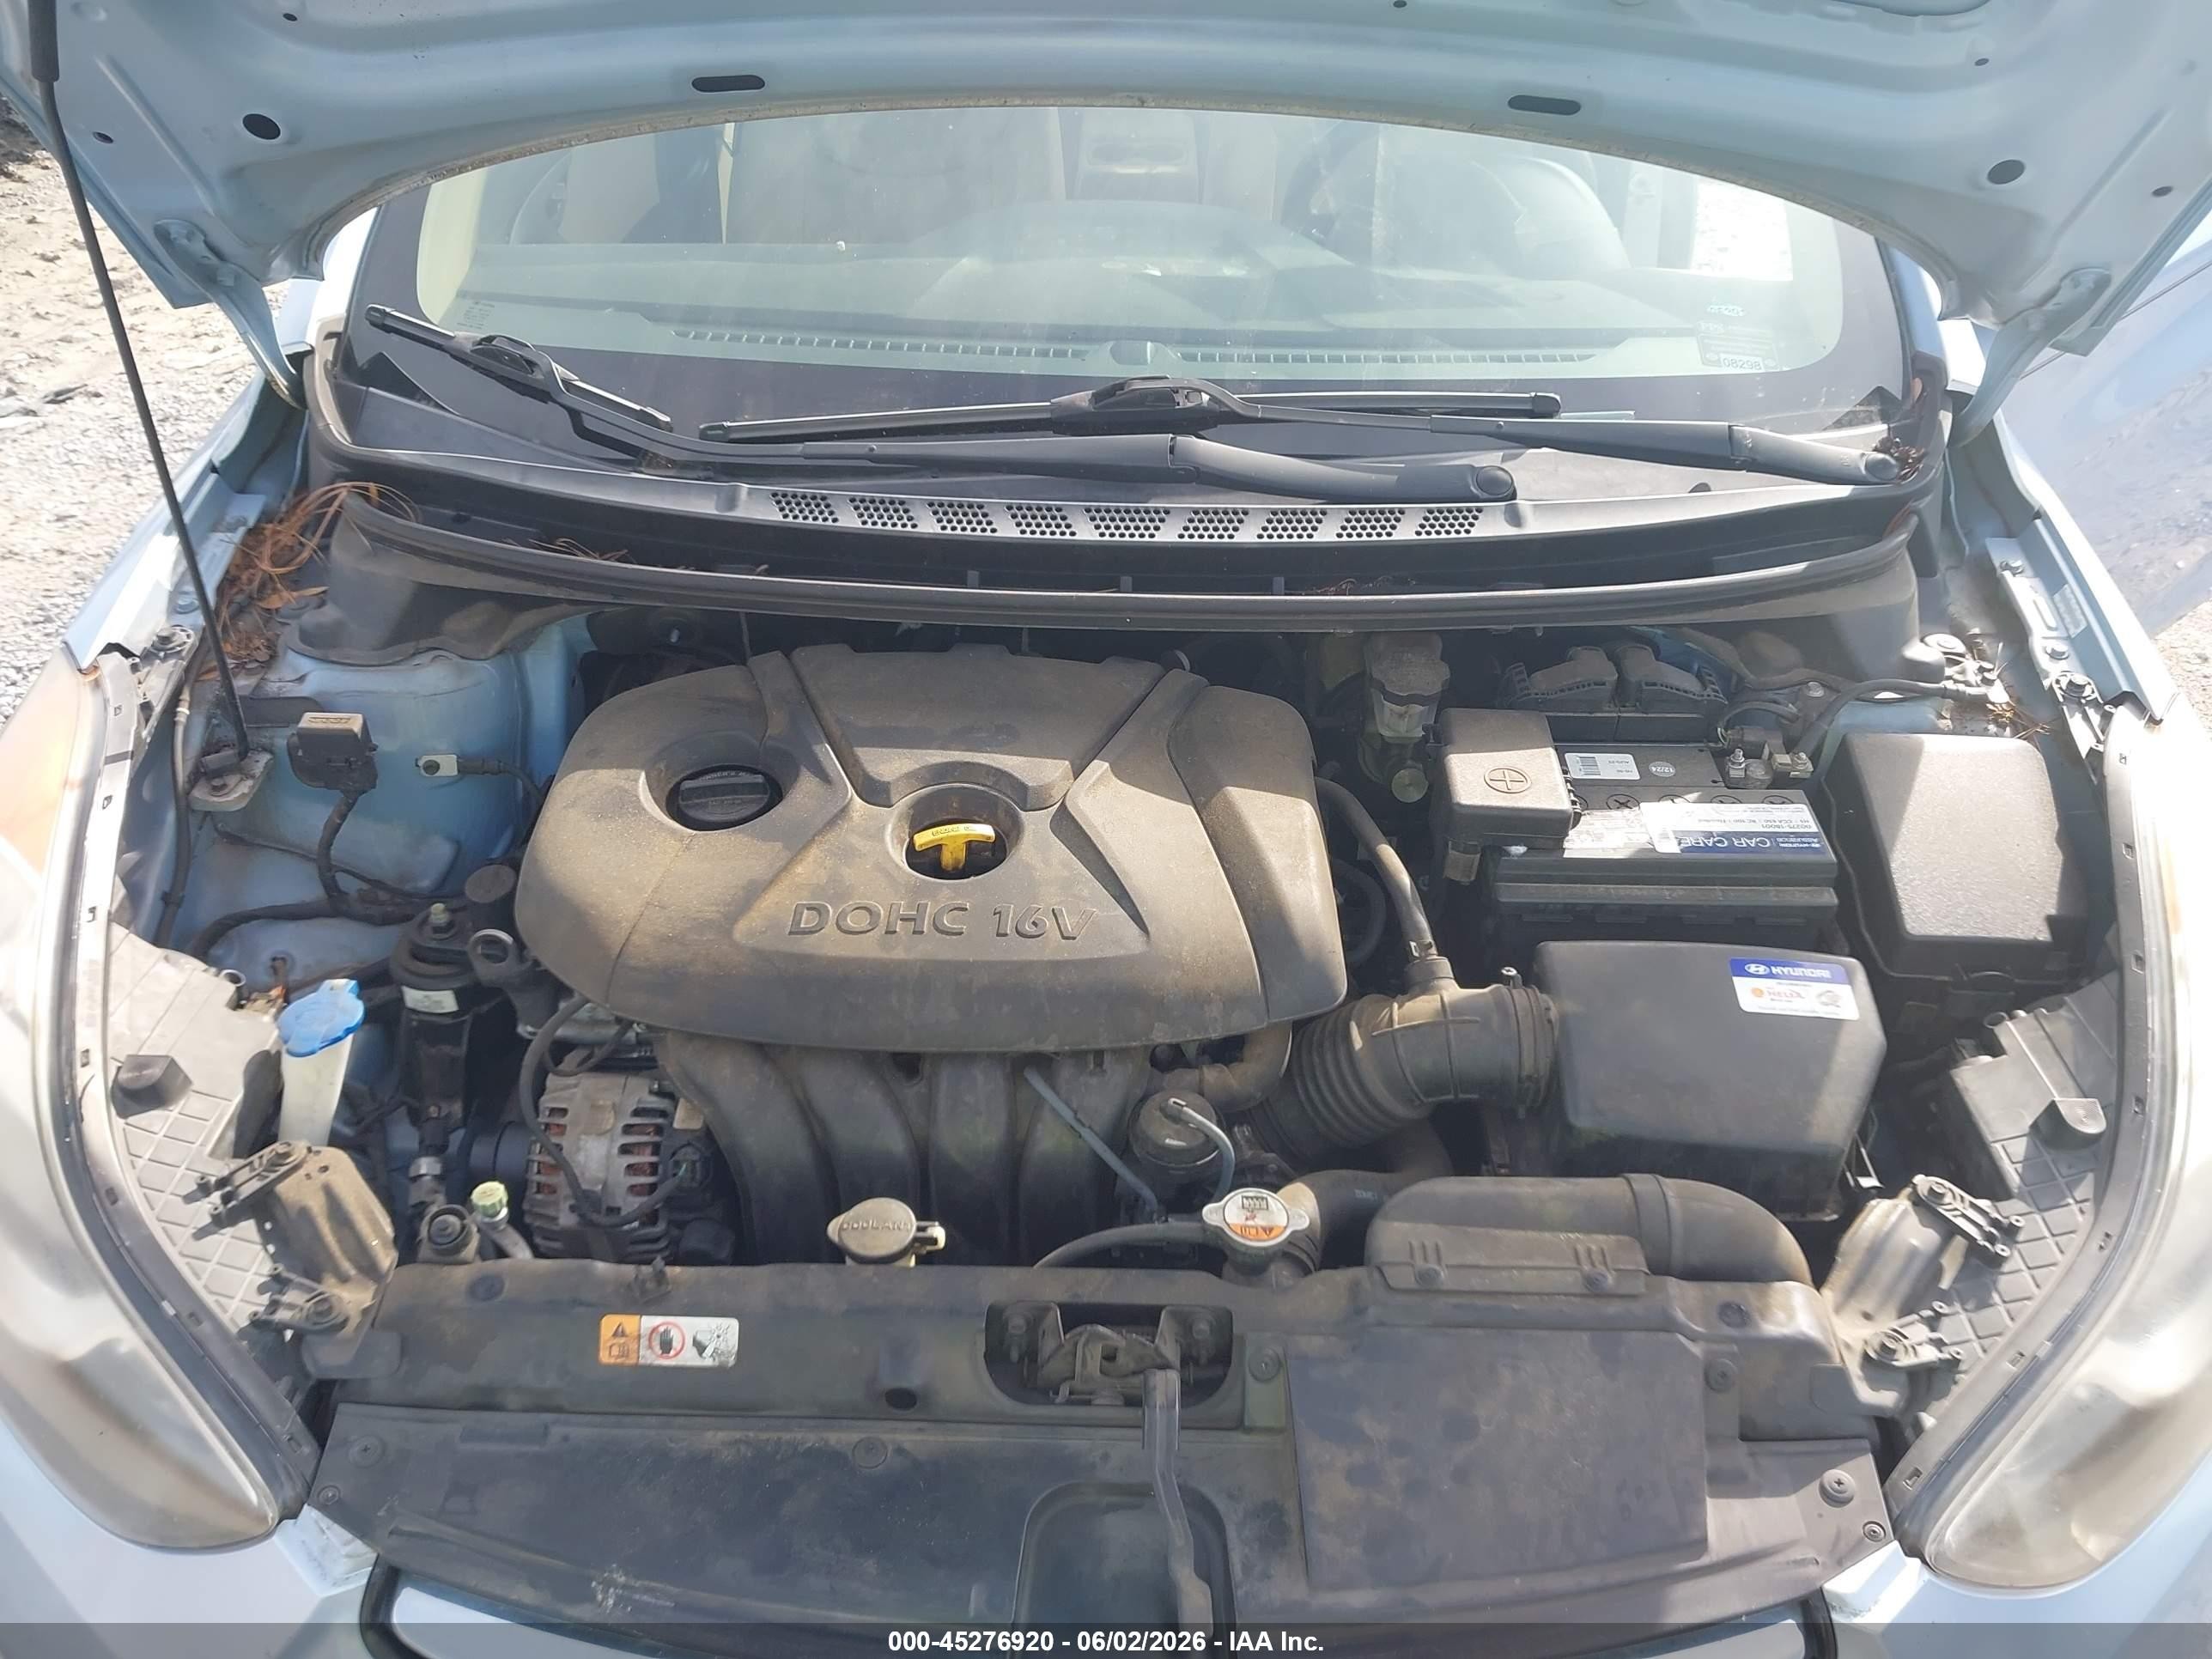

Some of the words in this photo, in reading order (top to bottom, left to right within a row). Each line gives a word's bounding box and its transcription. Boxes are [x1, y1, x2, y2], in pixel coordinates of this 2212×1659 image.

[1723, 358, 1761, 370] 08298
[1680, 836, 1728, 848] CARE
[1731, 836, 1771, 848] CAR
[788, 901, 969, 936] DOHC
[993, 903, 1097, 940] 16V
[1771, 965, 1832, 978] HYUNDAI
